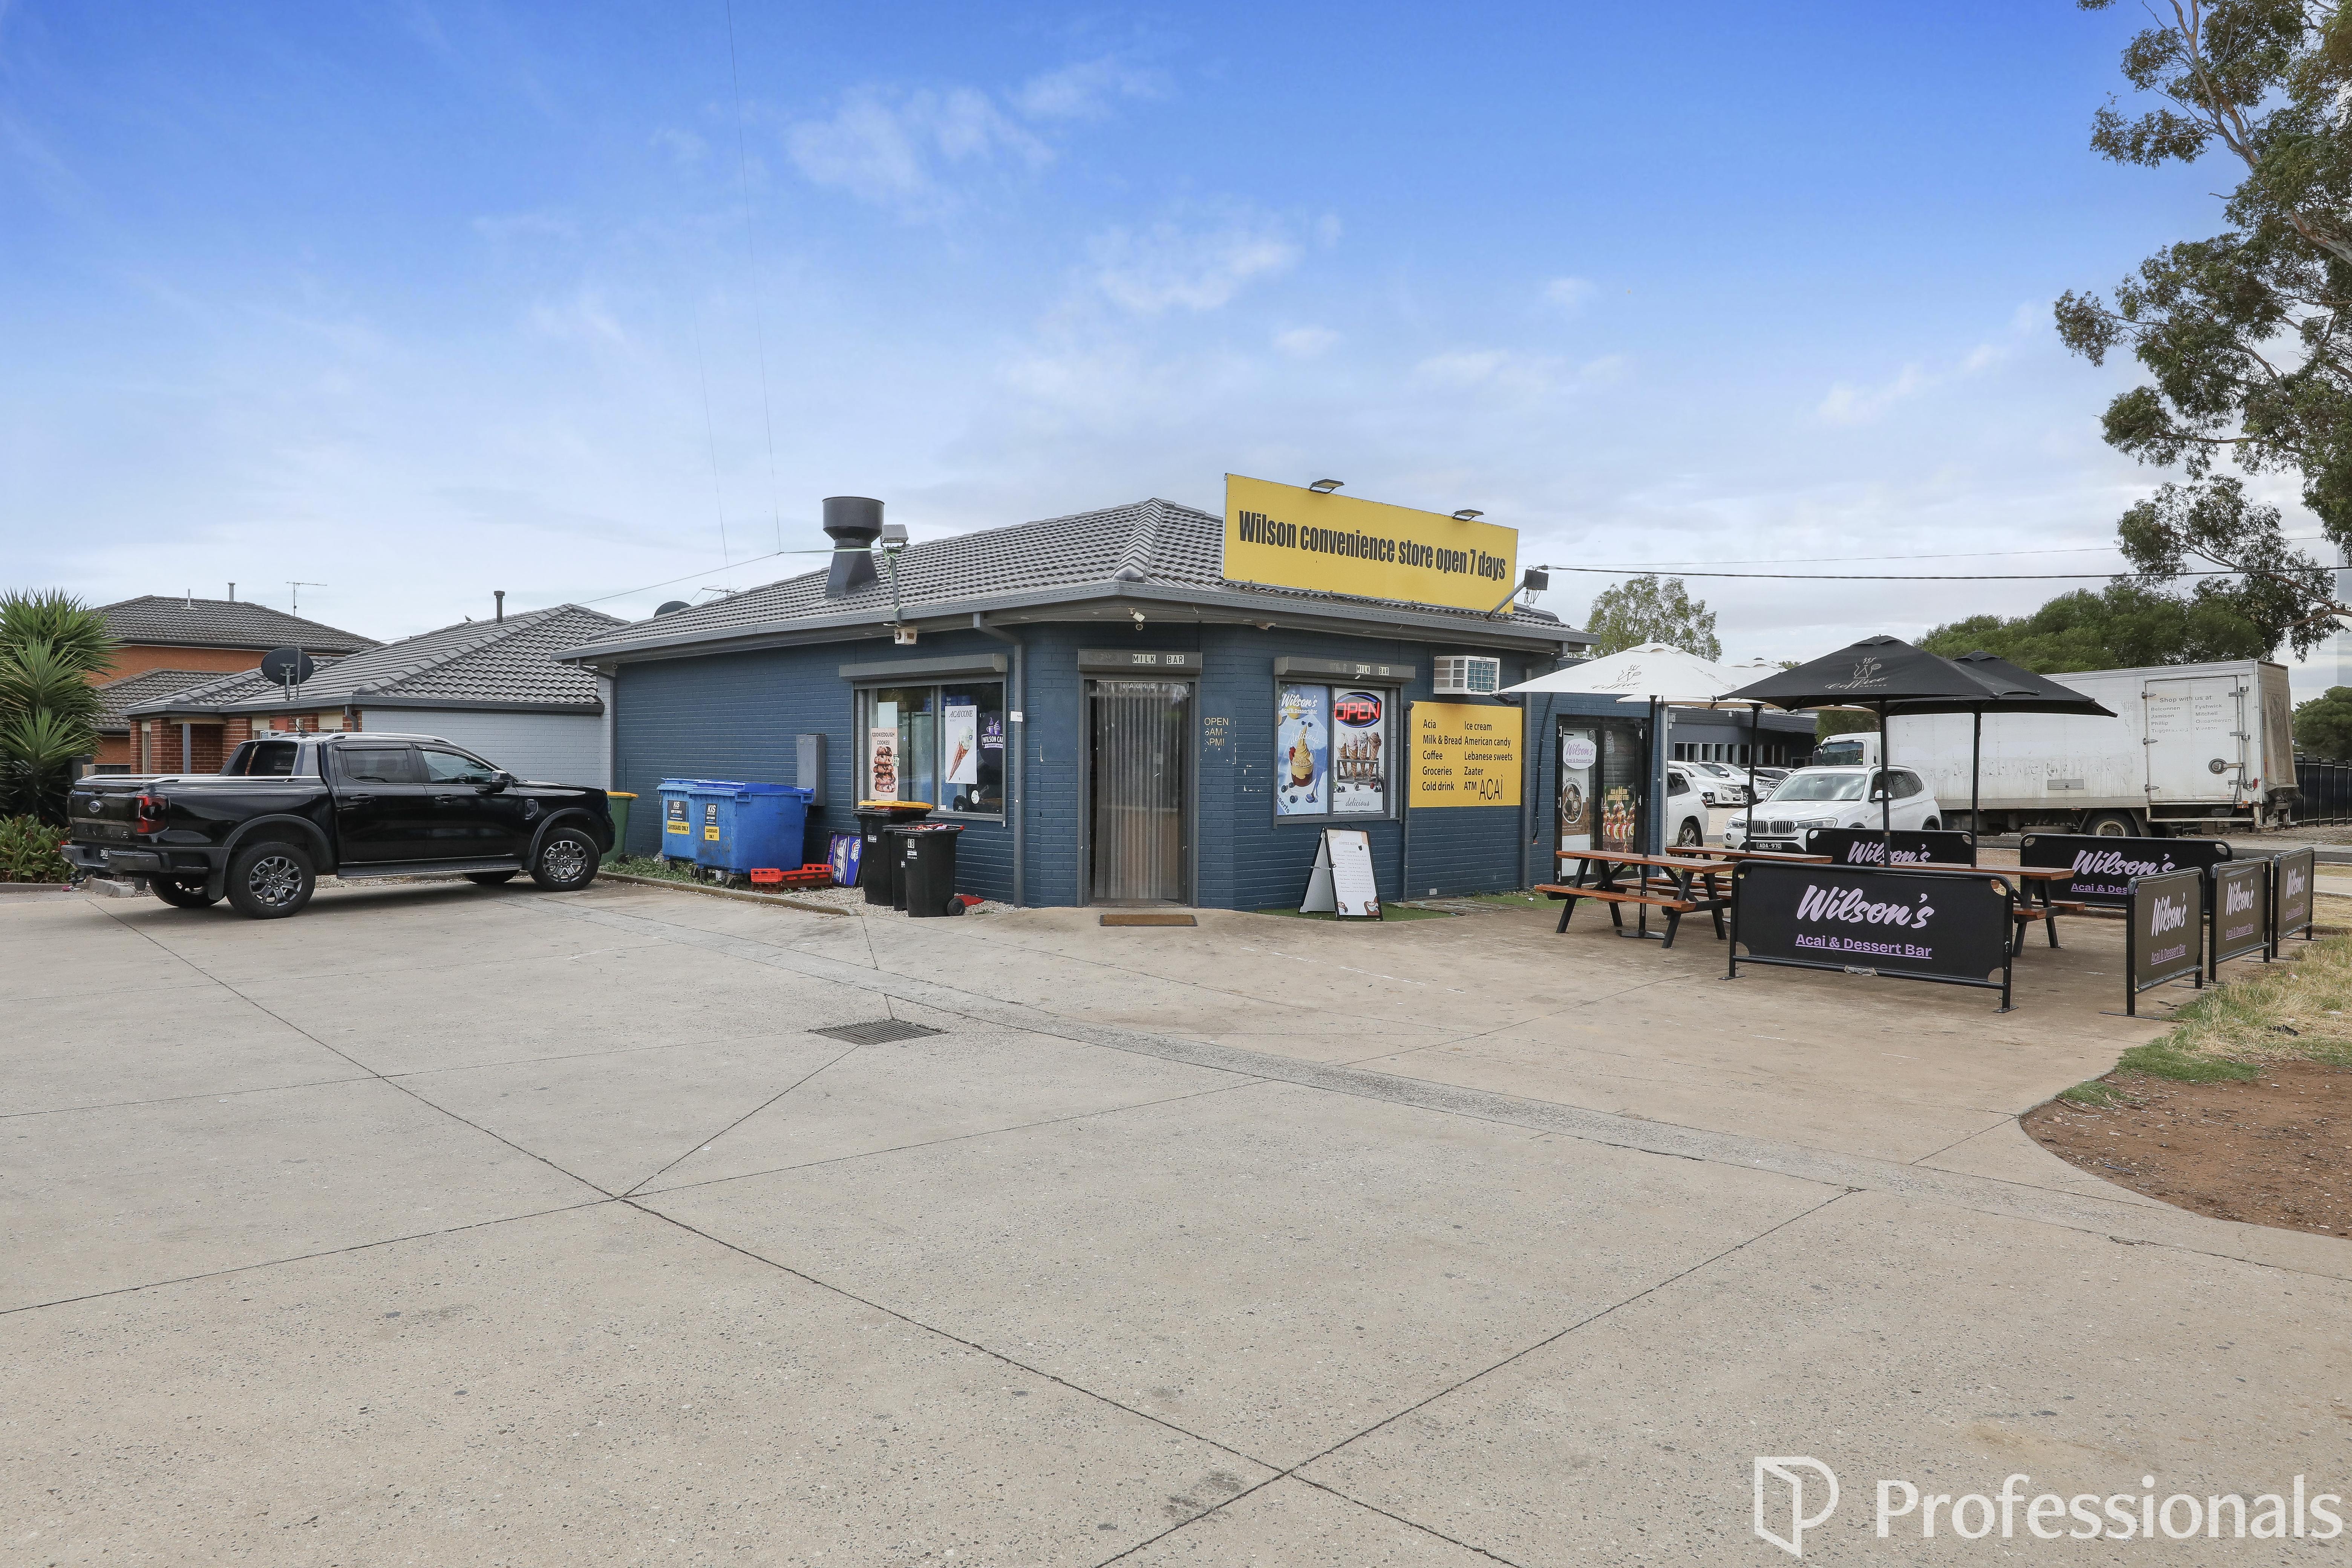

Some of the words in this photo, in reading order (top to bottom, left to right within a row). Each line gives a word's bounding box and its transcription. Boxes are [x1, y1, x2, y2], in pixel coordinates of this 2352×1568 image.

[1239, 510, 1296, 549] Wilson
[1300, 525, 1395, 563] convenience
[1398, 540, 1433, 570] store
[1436, 547, 1467, 574] open
[1470, 549, 1476, 575] 7
[1478, 551, 1506, 581] days
[1133, 654, 1156, 663] MILK
[1167, 655, 1184, 664] BAR
[1357, 665, 1370, 674] MILK
[1379, 667, 1389, 675] BAR
[1282, 693, 1318, 707] Wilson's
[1335, 702, 1380, 720] OPEN
[1204, 717, 1229, 726] OPEN
[1423, 719, 1436, 729] Acia
[1464, 721, 1473, 730] Ice
[1291, 730, 1319, 744] delicious
[1423, 735, 1437, 744] Milk
[1438, 735, 1443, 744] &
[1444, 735, 1462, 745] Bread
[1464, 736, 1492, 746] American
[1494, 737, 1511, 748] candy
[1566, 743, 1594, 756] Wilson's
[1423, 750, 1443, 760] Coffee
[1464, 751, 1492, 761] Lebanese
[1494, 753, 1513, 761] sweets
[1423, 766, 1452, 775] Groceries
[1464, 766, 1484, 776] Zaater
[1422, 781, 1436, 791] Cold
[1438, 781, 1455, 791] drink
[1464, 781, 1477, 790] ATM
[1346, 797, 1369, 806] delicious
[707, 805, 716, 813] KIS
[908, 839, 914, 848] 48
[2072, 850, 2175, 875] Wilson's
[2286, 865, 2305, 899] Wilson's
[2226, 879, 2254, 916] Wilson's
[1796, 885, 1935, 929] Wilson's
[2151, 892, 2187, 937] Wilson's
[2236, 925, 2248, 936] Dessert
[1796, 934, 1826, 946] Acai
[1829, 937, 1840, 948] &
[1844, 938, 1901, 954] Dessert
[1905, 944, 1932, 957] Bar
[2151, 949, 2160, 963] Acai
[2161, 950, 2164, 960] &
[2164, 945, 2179, 959] Dessert
